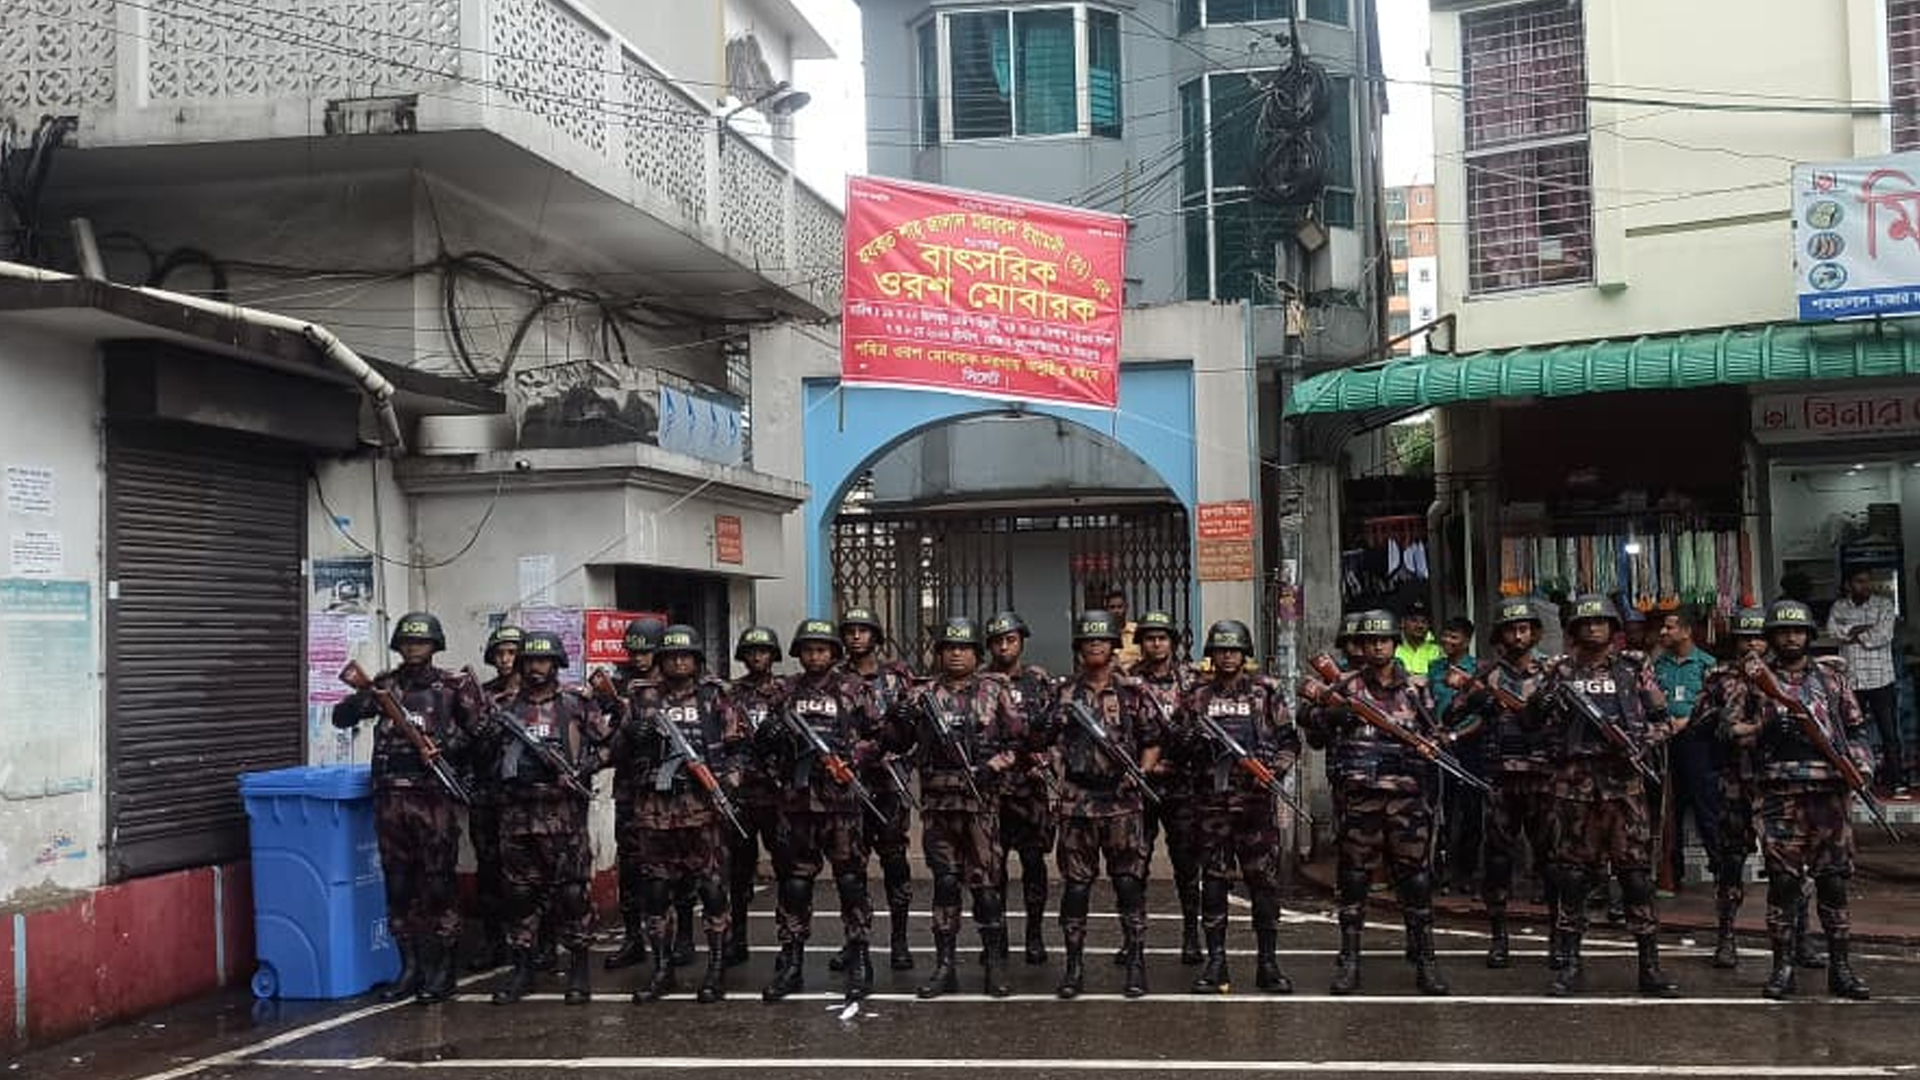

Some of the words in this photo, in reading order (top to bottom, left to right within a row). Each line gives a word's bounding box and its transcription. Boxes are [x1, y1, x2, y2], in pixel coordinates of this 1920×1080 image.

[917, 242, 1058, 287] বাৎসরিক
[874, 271, 953, 306] ওরশ
[968, 282, 1097, 324] মোবারক
[797, 700, 837, 716] BGB
